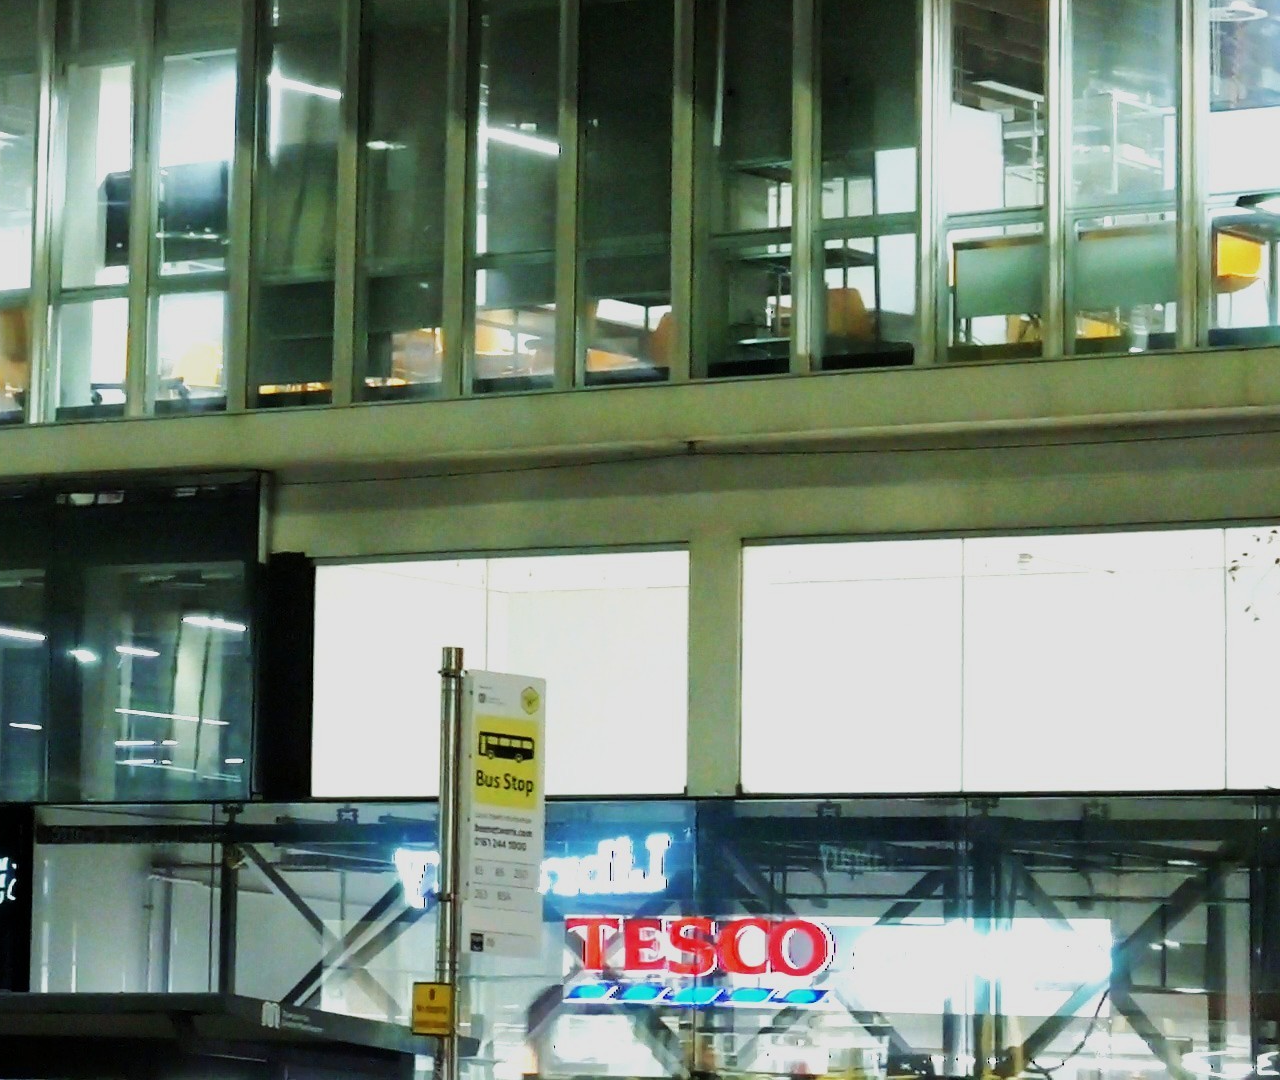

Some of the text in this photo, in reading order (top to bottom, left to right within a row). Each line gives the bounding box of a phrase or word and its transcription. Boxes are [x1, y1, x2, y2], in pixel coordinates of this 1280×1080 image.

[476, 769, 534, 797] Bus Stop
[565, 916, 831, 978] TESCO
